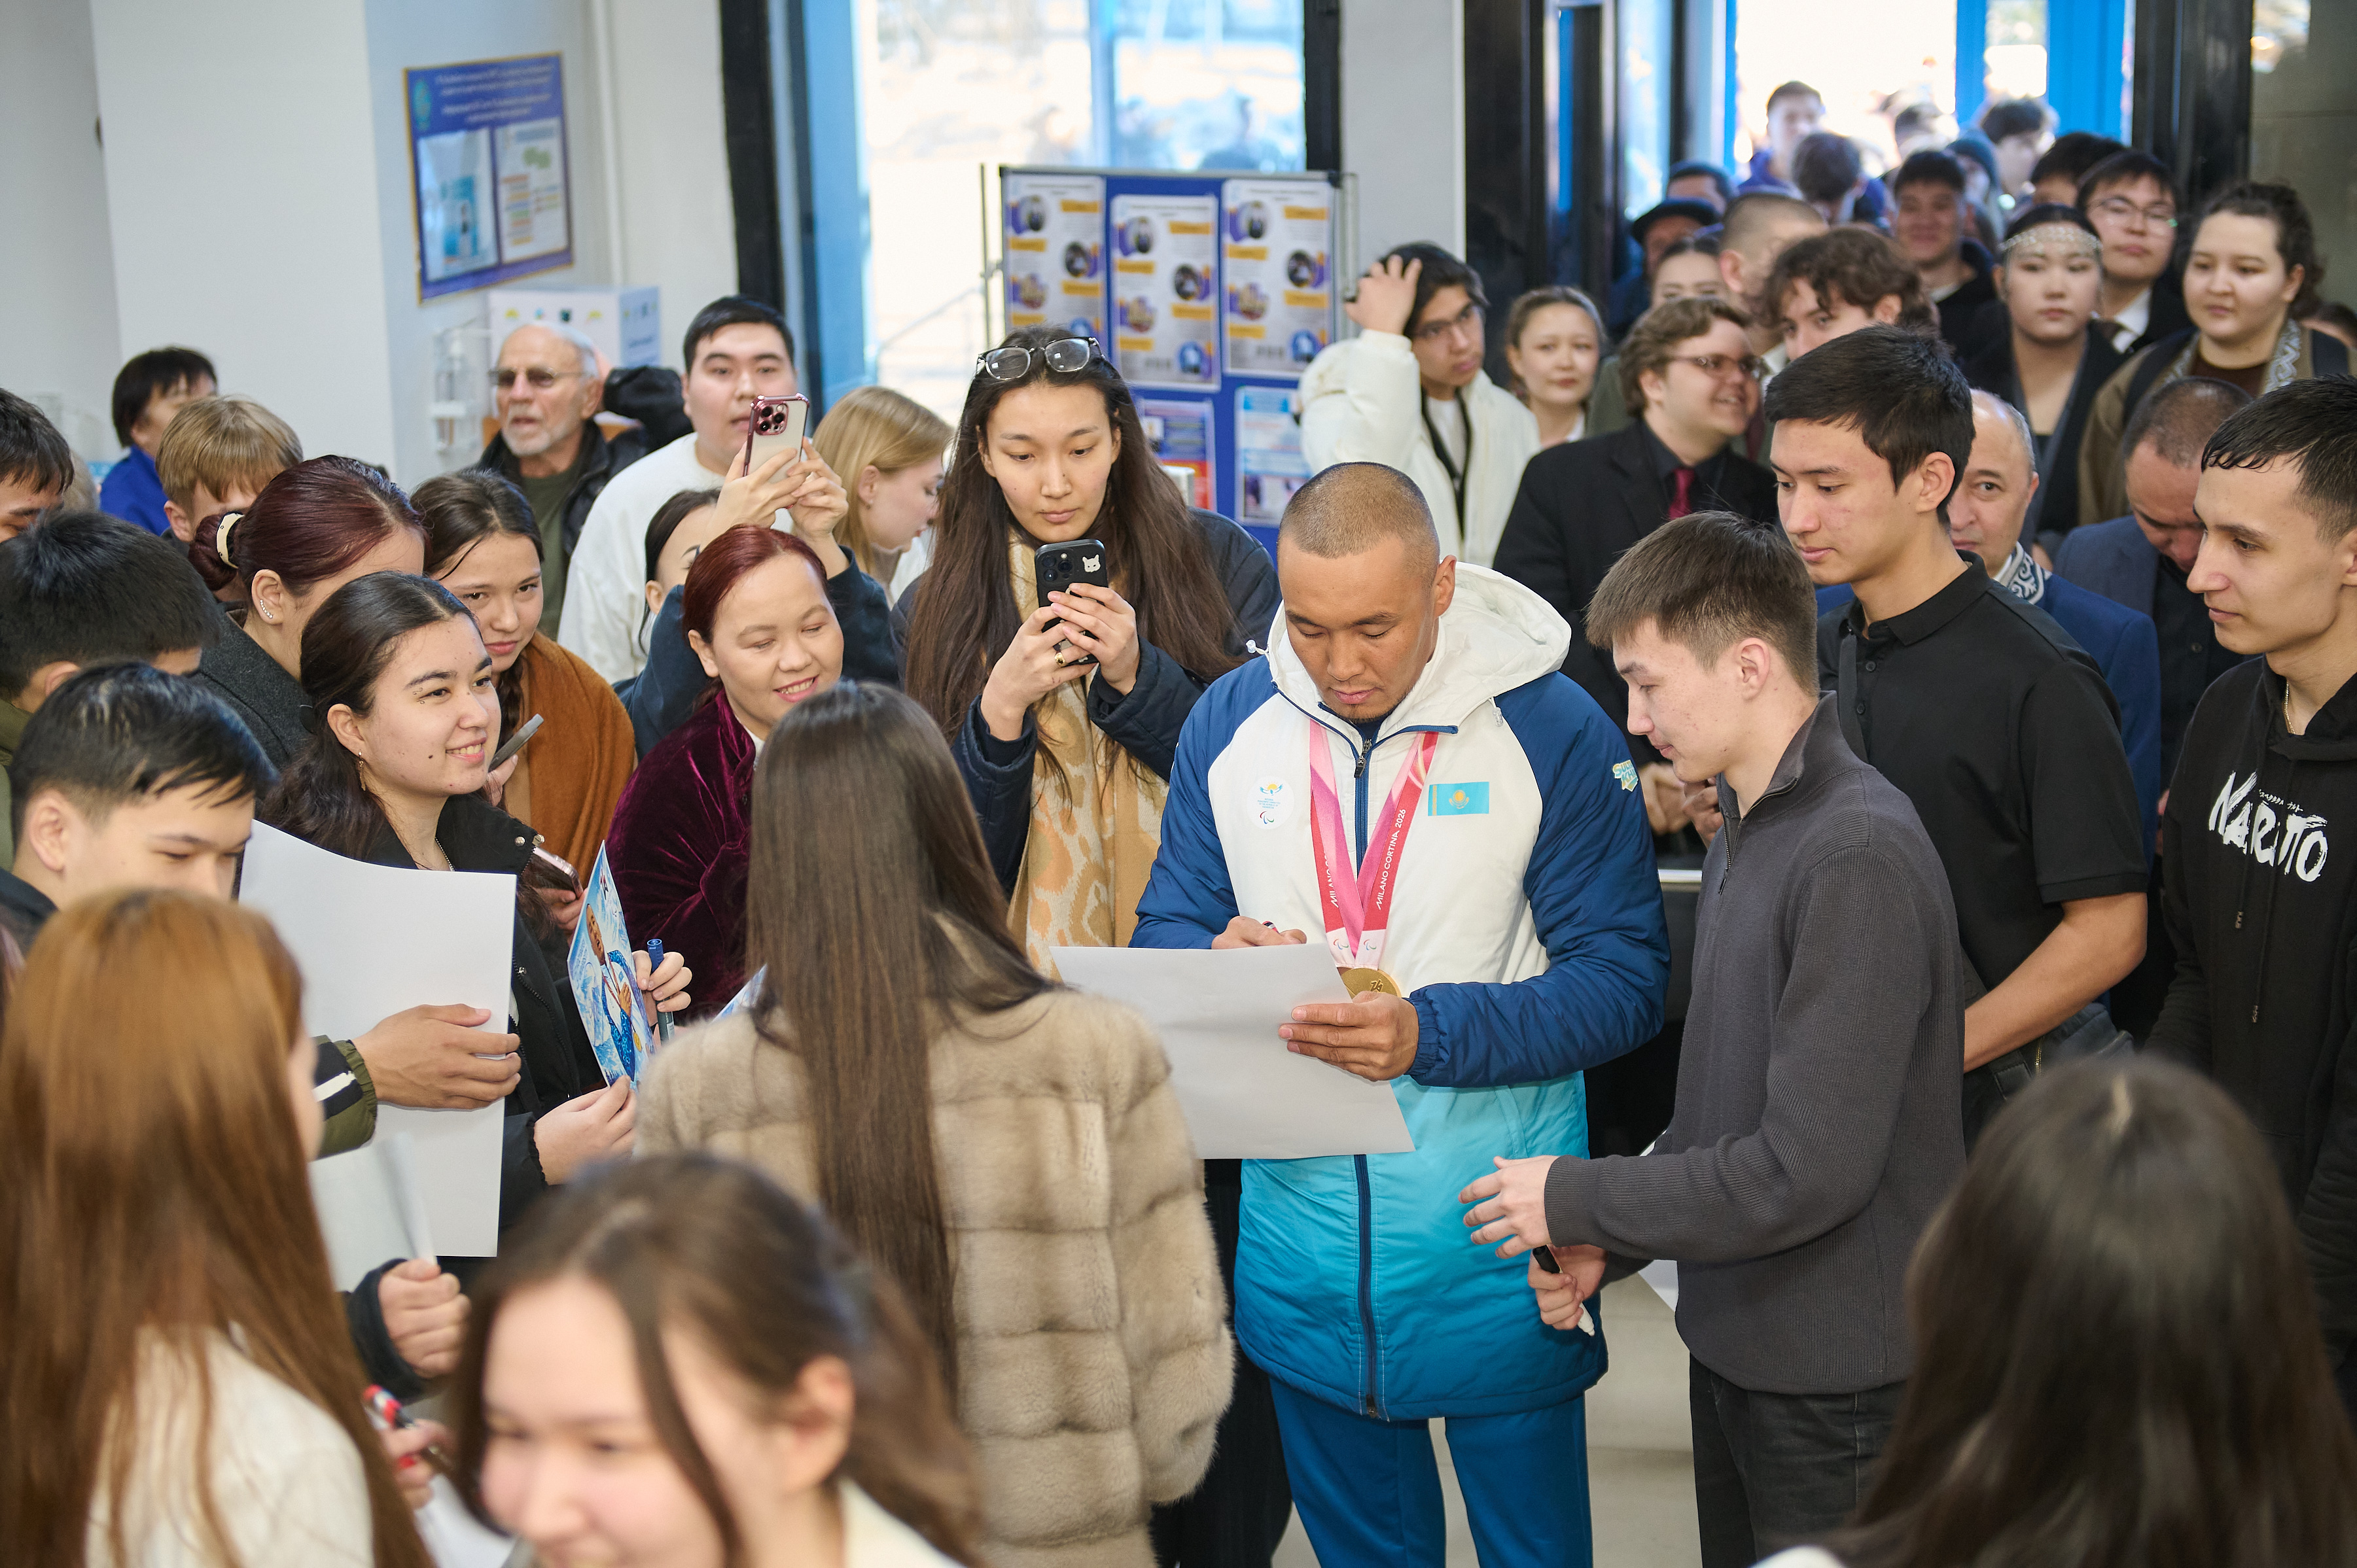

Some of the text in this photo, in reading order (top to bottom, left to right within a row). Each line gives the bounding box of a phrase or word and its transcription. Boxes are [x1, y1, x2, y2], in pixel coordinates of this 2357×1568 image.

[1375, 809, 1406, 910] MILANO CORTINA 2026
